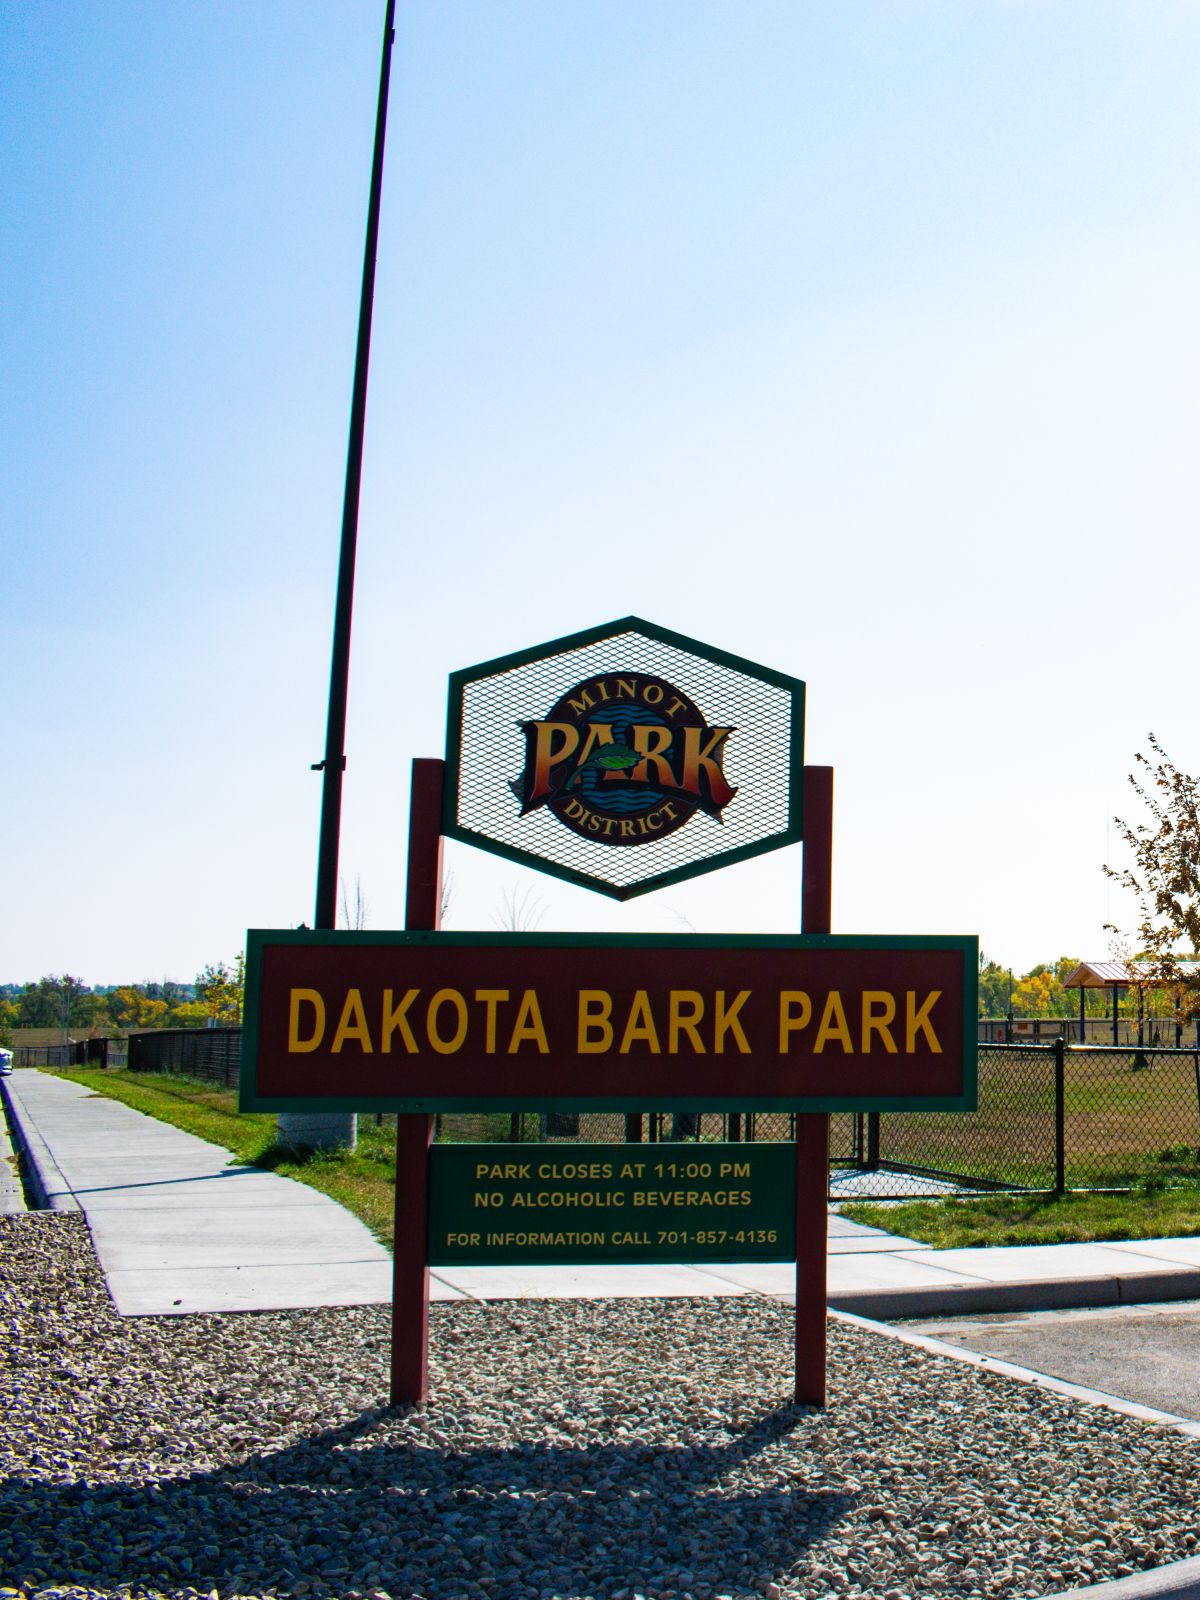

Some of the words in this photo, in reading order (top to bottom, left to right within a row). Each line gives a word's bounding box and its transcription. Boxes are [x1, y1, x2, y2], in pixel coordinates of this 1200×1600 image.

[567, 679, 688, 718] MINOT
[530, 721, 738, 804] PARK
[563, 798, 681, 837] DISTRICT
[288, 988, 550, 1055] DAKOTA
[577, 990, 752, 1055] BARK
[779, 990, 943, 1055] PARK
[476, 1164, 531, 1179] PARK
[538, 1164, 613, 1179] CLOSES
[620, 1163, 646, 1178] AT
[654, 1163, 712, 1178] 11:00
[720, 1163, 751, 1178] PM
[475, 1192, 504, 1207] NO
[511, 1192, 625, 1207] ALCOHOLIC
[633, 1191, 752, 1206] BEVERAGES
[447, 1233, 481, 1246] FOR
[487, 1232, 605, 1246] INFORMATION
[611, 1231, 651, 1245] CALL
[657, 1230, 778, 1244] 701-857-4136
